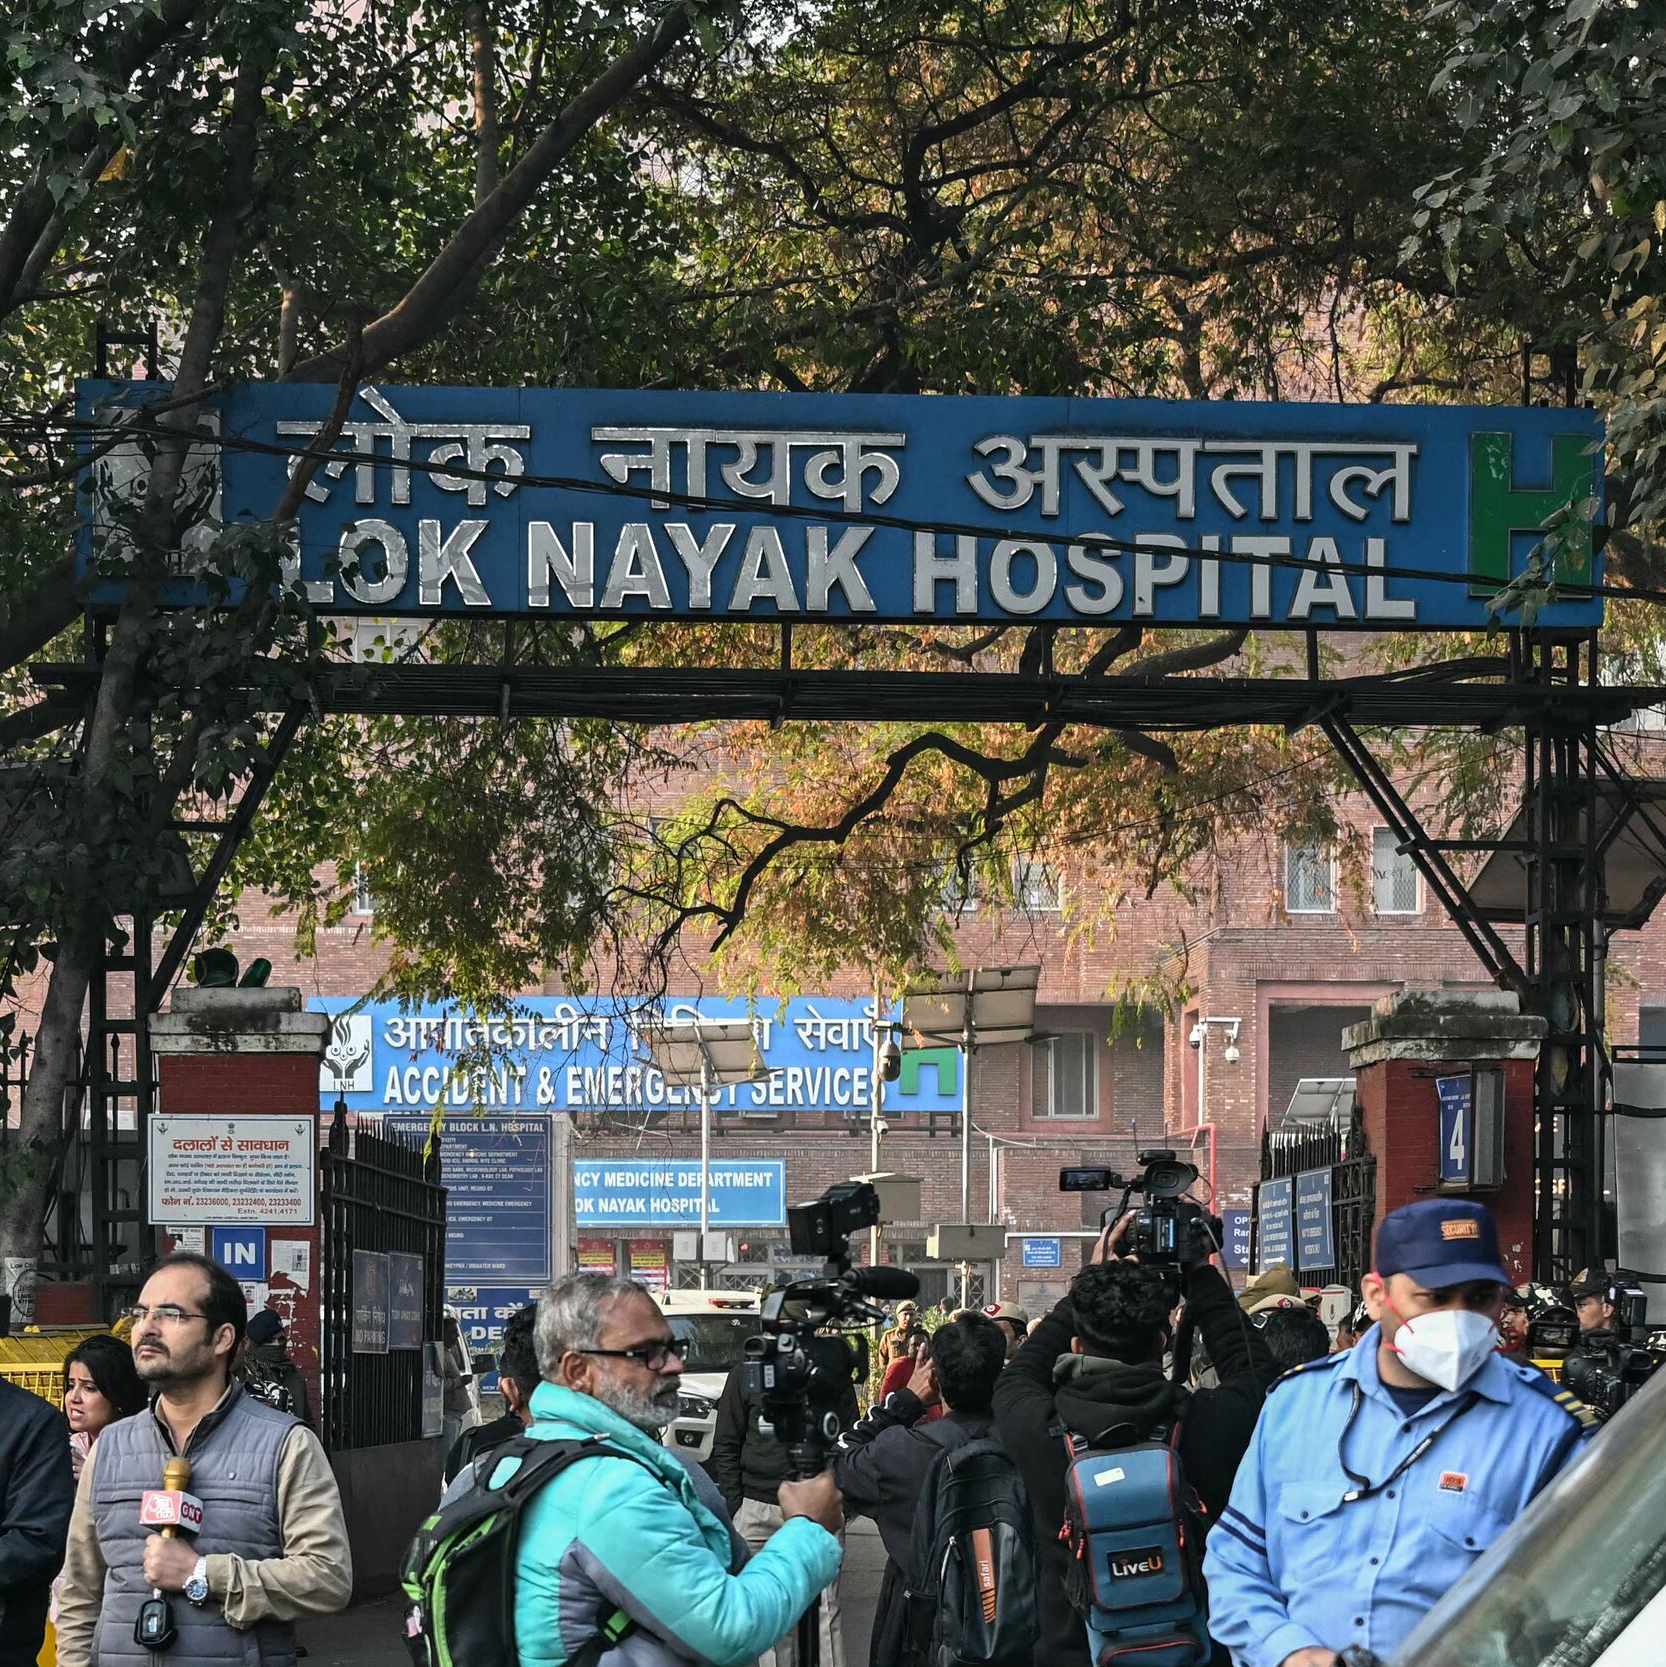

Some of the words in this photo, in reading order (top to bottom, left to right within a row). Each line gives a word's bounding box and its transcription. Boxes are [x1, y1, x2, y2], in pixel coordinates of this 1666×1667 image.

[277, 386, 530, 504] लोक
[591, 426, 905, 512] नायक
[967, 435, 1419, 522] अस्पताल
[279, 518, 491, 605] LOK
[528, 521, 875, 612] NAYAK
[914, 530, 1417, 620] HOSPITAL
[333, 1080, 355, 1091] LNH
[384, 1066, 526, 1105] ACCIDENT
[537, 1066, 556, 1105] &
[392, 1122, 447, 1132] EMERGEY
[449, 1122, 479, 1132] BLOCK
[481, 1122, 498, 1132] L.N.
[501, 1122, 544, 1132] HOSPITAL
[173, 1136, 218, 1152] दलालों
[221, 1136, 233, 1152] से
[237, 1139, 290, 1152] सावधान
[1450, 1109, 1465, 1170] 4
[604, 1172, 674, 1187] MEDICINE
[678, 1172, 774, 1187] DEPARTMENT
[162, 1196, 181, 1206] फोन
[195, 1197, 231, 1206] 23236000,
[233, 1197, 267, 1206] 23232400,
[268, 1197, 301, 1206] 23233400
[576, 1199, 594, 1213] OK
[598, 1199, 646, 1213] NAYAK
[650, 1199, 720, 1213] HOSPITL
[1234, 1217, 1250, 1225] OP
[1441, 1223, 1477, 1237] SECURITY
[223, 1242, 256, 1265] IN
[355, 1329, 364, 1343] NO
[364, 1330, 386, 1344] PARKING
[471, 1326, 506, 1341] DE
[182, 1502, 202, 1523] GNT
[980, 1560, 989, 1588] safari
[1111, 1556, 1162, 1577] LiveU
